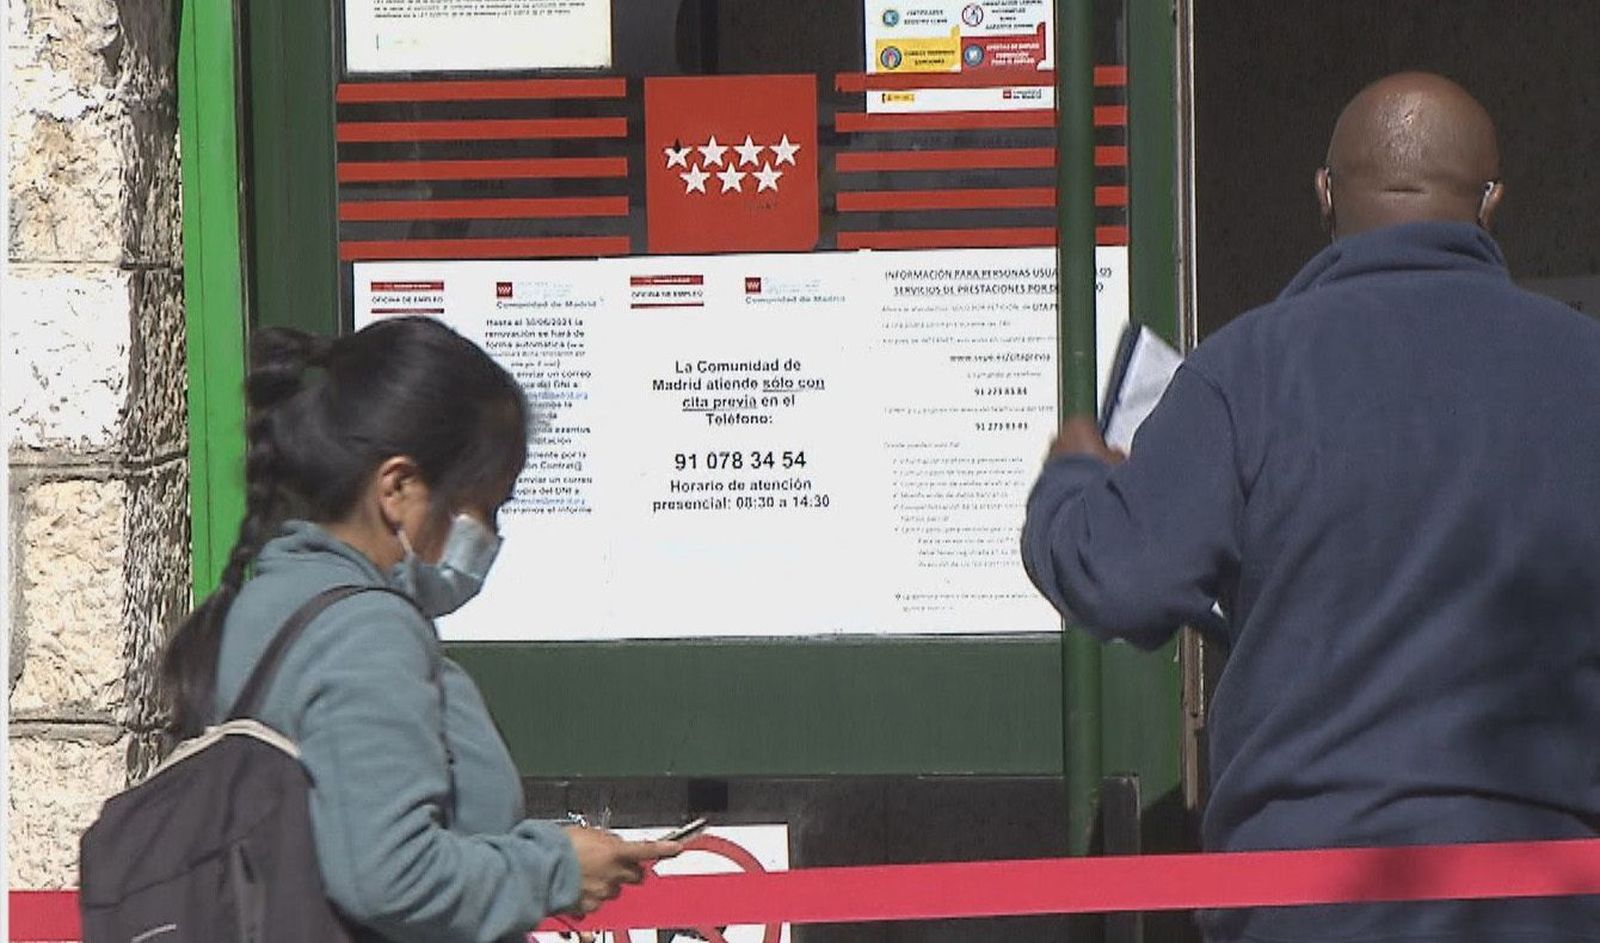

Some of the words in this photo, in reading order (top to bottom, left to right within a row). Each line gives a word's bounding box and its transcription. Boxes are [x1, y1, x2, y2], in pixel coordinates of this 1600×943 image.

[885, 269, 952, 281] INFORMACIÓN
[954, 269, 979, 281] PARA
[981, 268, 1030, 279] PERSONAS
[894, 286, 941, 296] SERVICIOS
[943, 286, 954, 295] DE
[957, 284, 1025, 295] PRESTACIONES
[1028, 284, 1047, 294] POR
[675, 360, 692, 374] La
[697, 358, 779, 373] Comunidad
[784, 358, 801, 371] de
[652, 377, 702, 391] Madrid
[706, 377, 758, 390] atiende
[763, 376, 794, 389] sólo
[798, 378, 825, 390] con
[682, 396, 708, 409] cita
[713, 394, 757, 410] previa
[761, 396, 778, 408] en
[782, 394, 795, 407] el
[706, 412, 773, 426] Teléfono:
[675, 453, 697, 470] 91
[706, 452, 743, 470] 078
[750, 451, 775, 469] 34
[782, 451, 807, 469] 54
[670, 479, 724, 493] Horario
[728, 479, 745, 491] de
[750, 477, 812, 491] atención
[652, 496, 731, 512] presencial:
[736, 495, 775, 508] 08:30
[779, 498, 787, 508] a
[792, 494, 830, 508] 14:30
